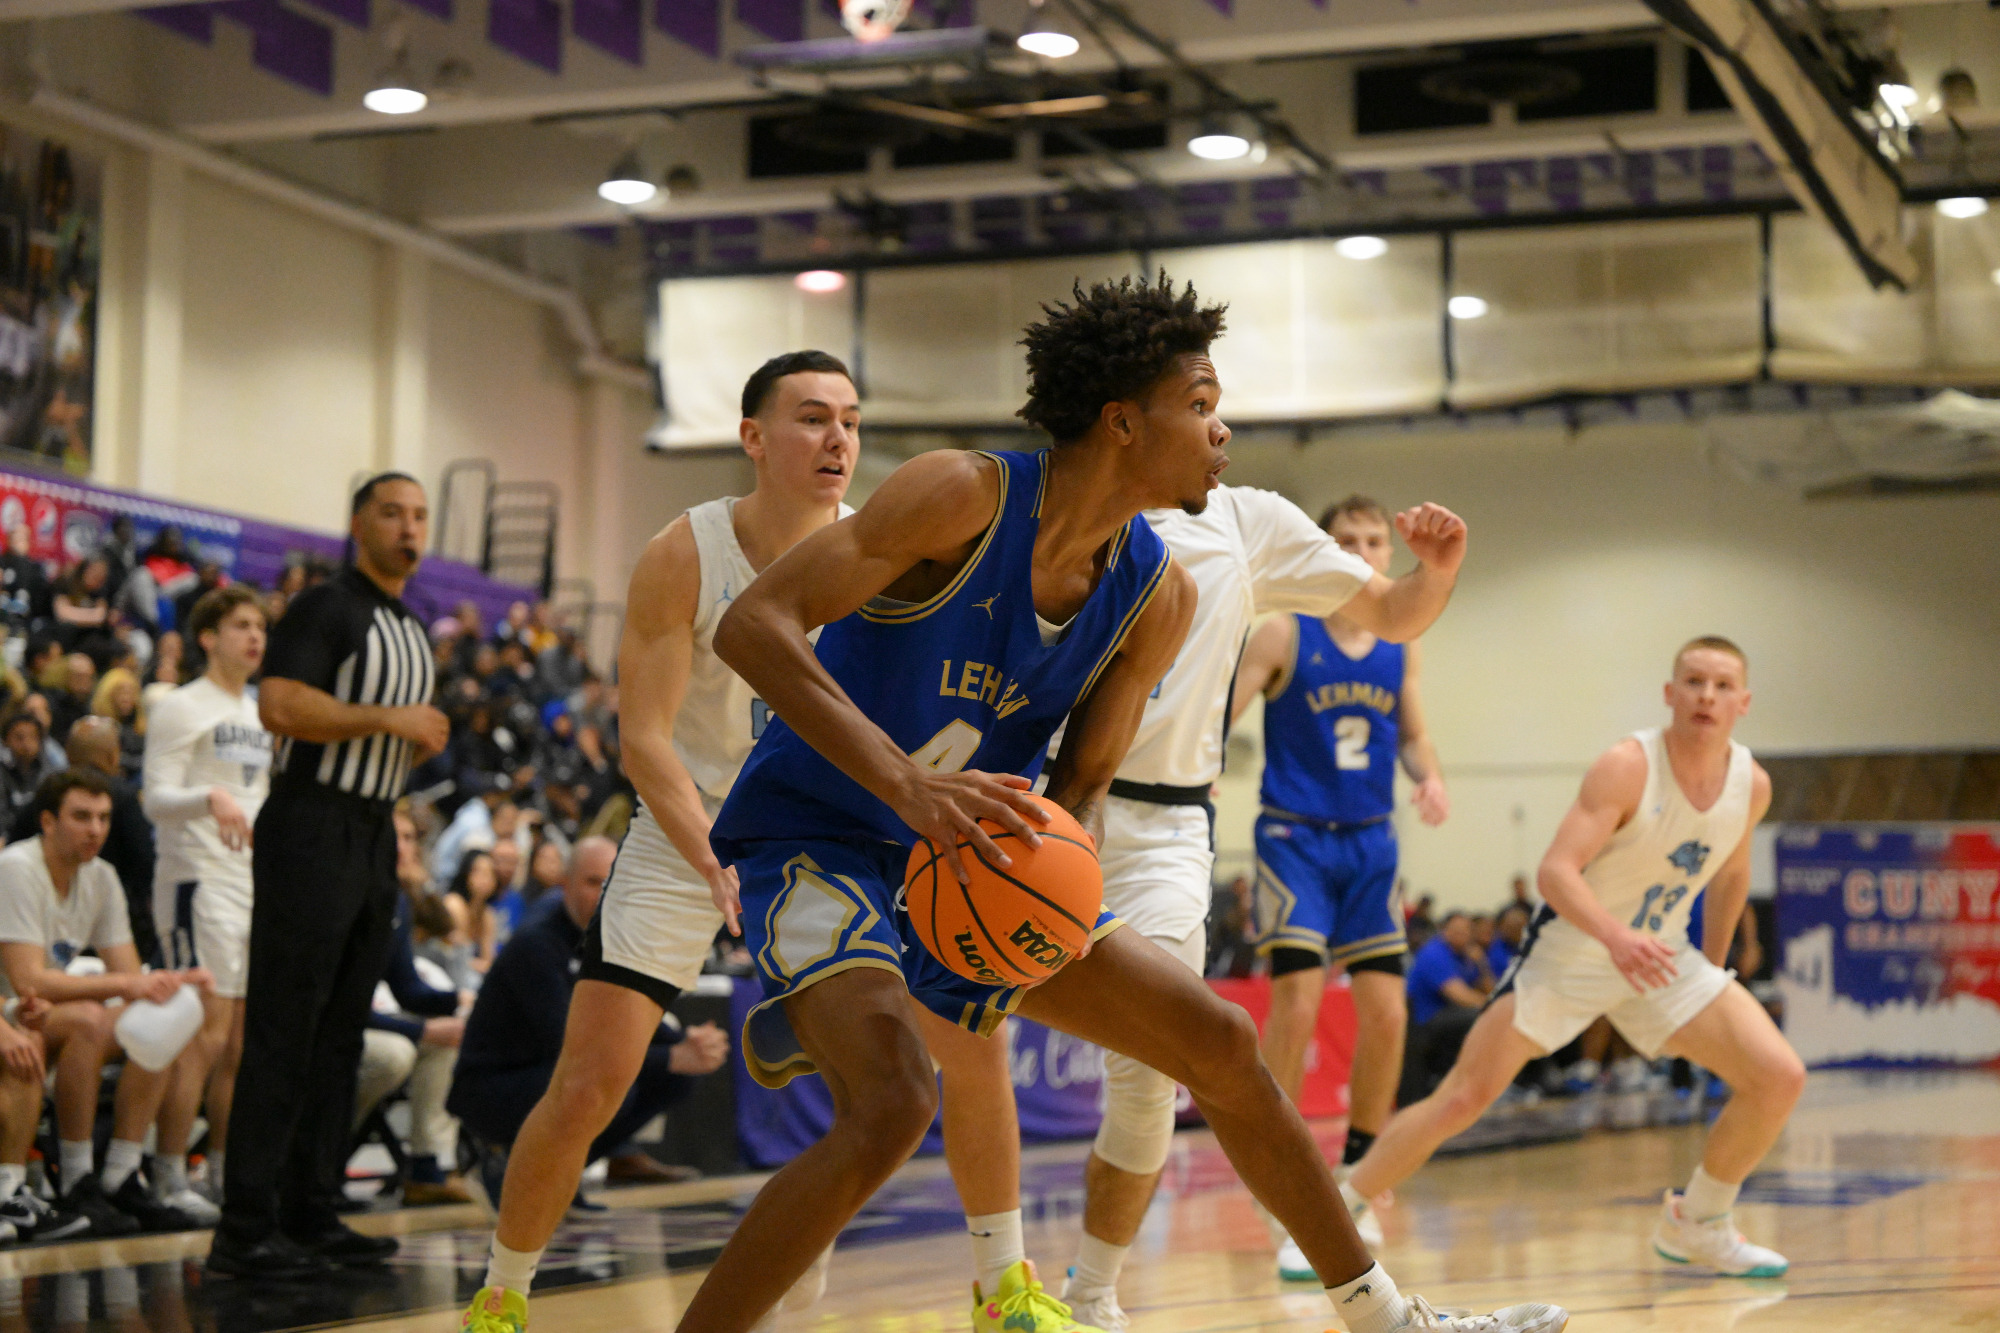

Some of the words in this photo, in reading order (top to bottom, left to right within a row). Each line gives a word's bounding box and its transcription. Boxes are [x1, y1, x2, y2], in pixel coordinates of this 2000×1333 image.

[1305, 681, 1396, 715] LEHMAN
[1333, 715, 1371, 770] 2
[1843, 867, 2000, 920] CUNY
[1009, 919, 1074, 971] NCAA
